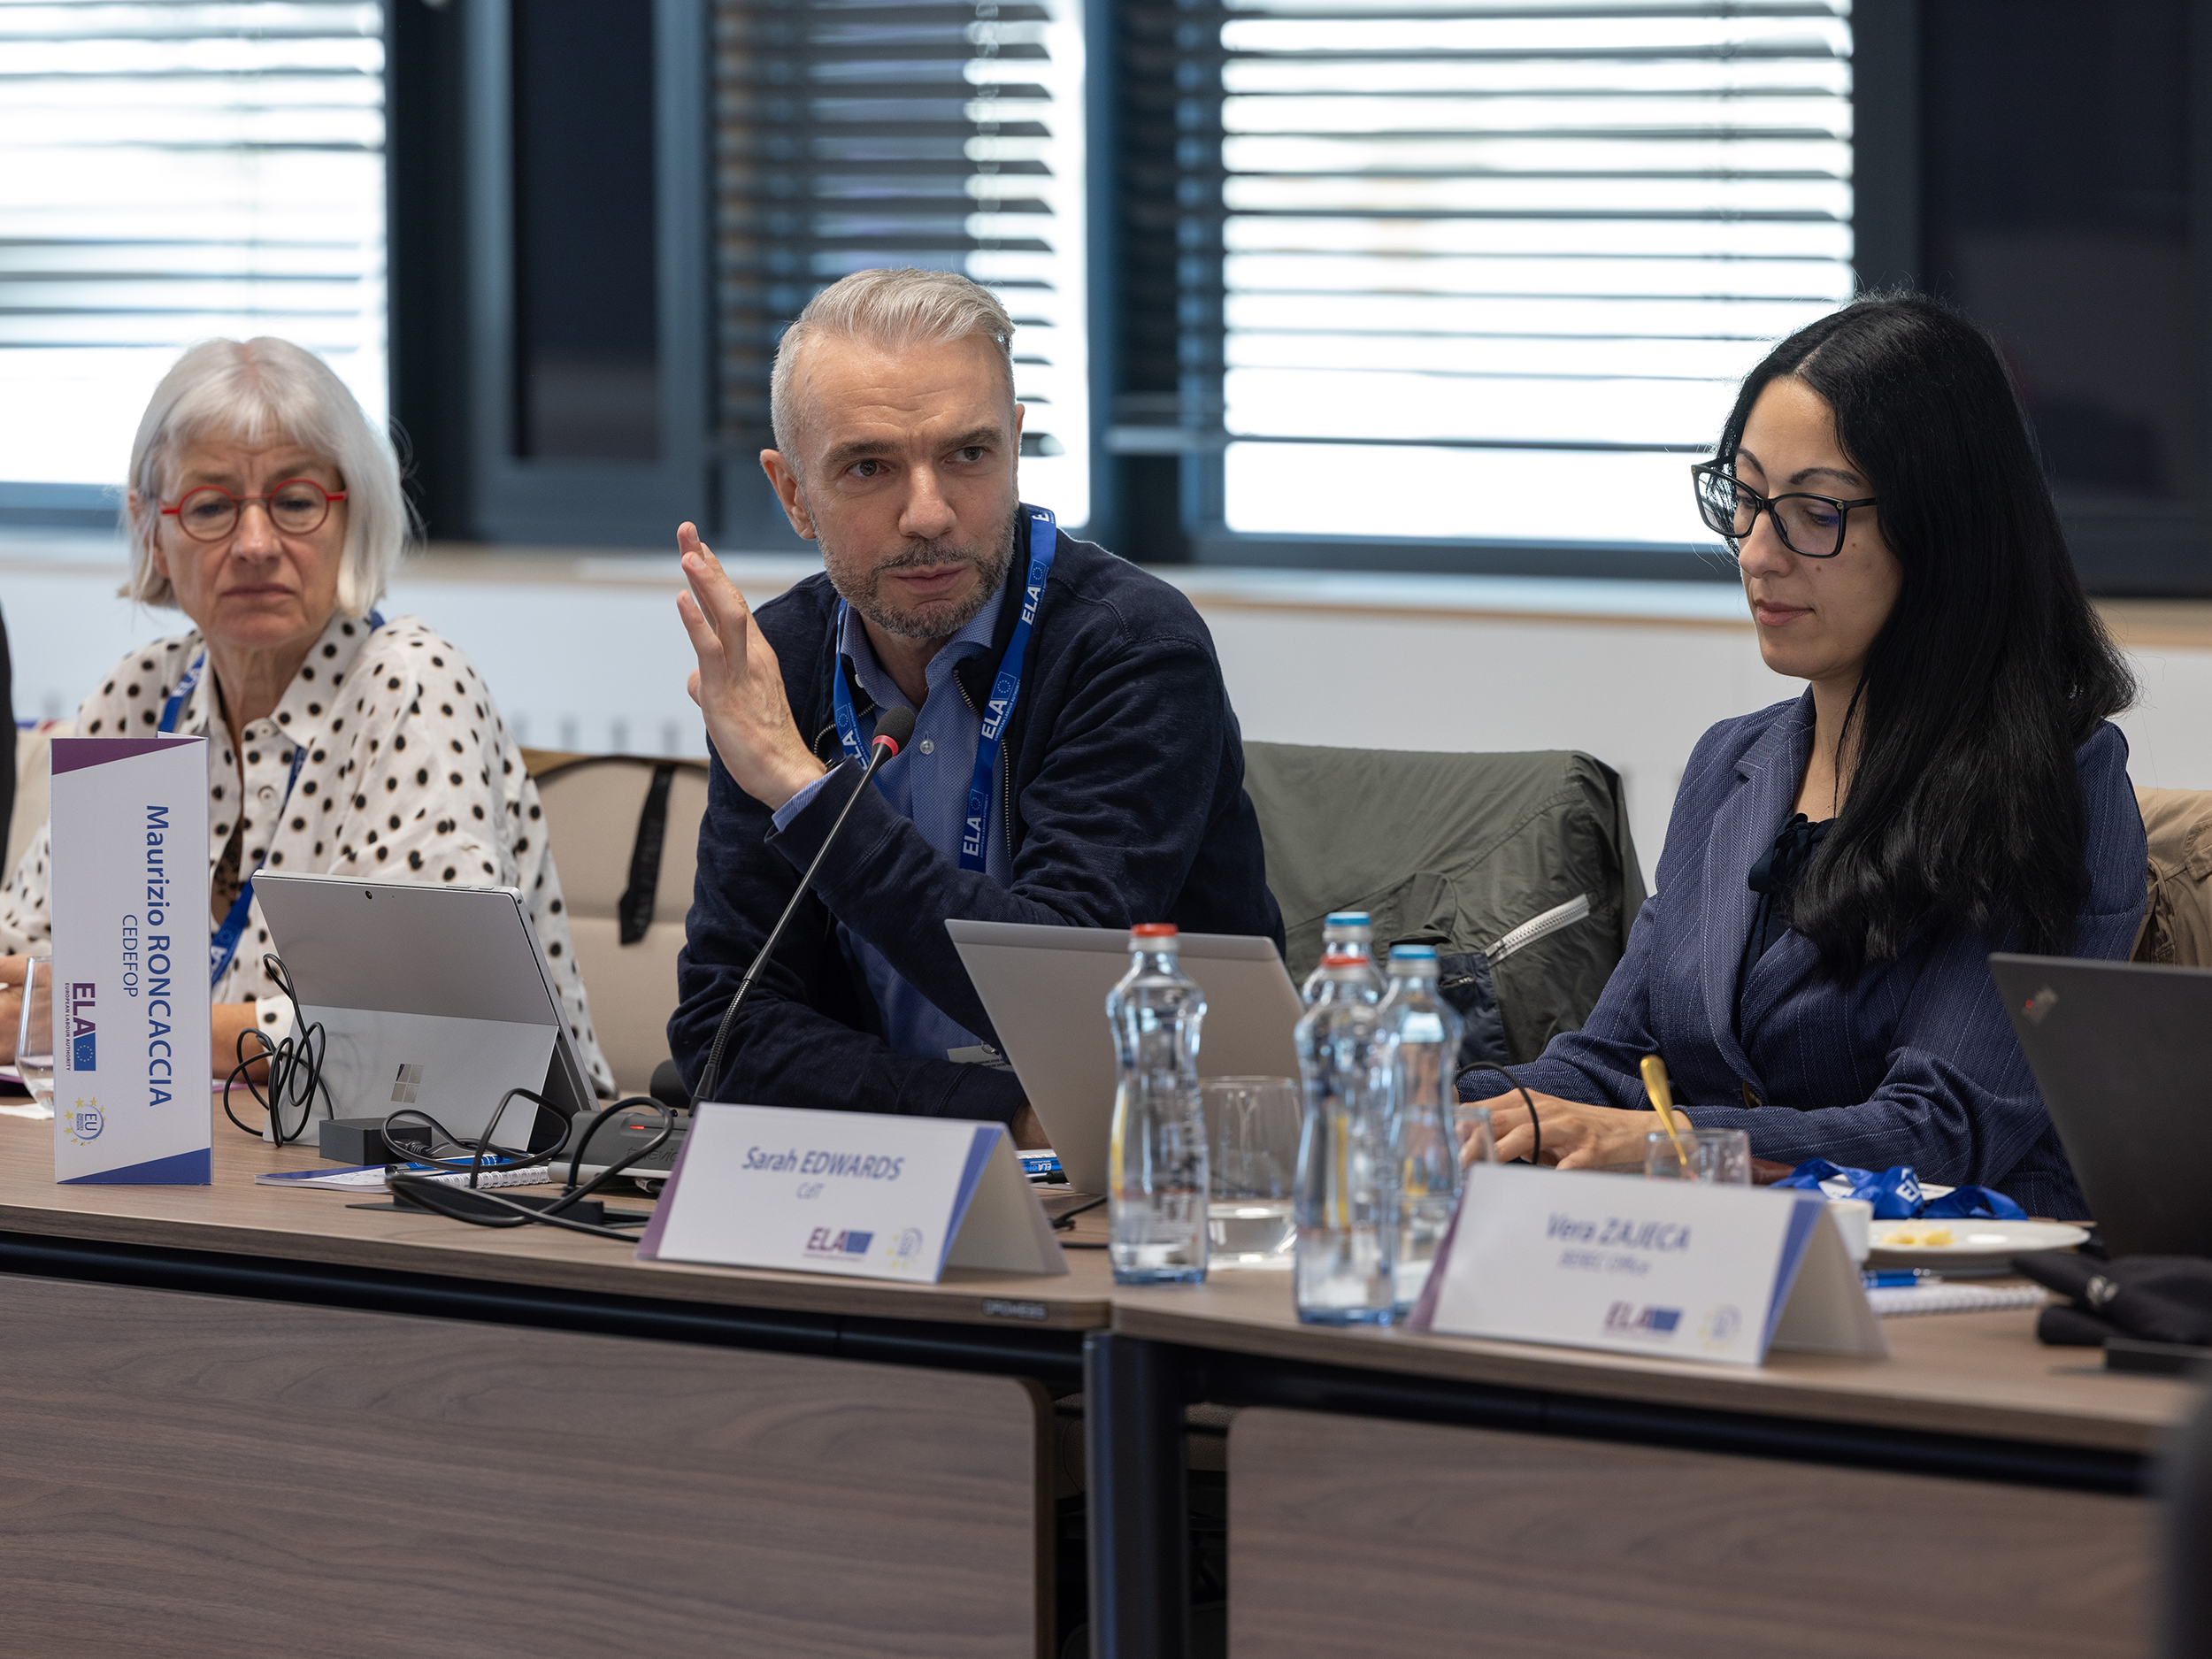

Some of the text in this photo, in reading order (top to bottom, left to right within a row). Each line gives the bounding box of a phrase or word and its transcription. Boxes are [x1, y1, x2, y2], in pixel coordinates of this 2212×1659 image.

[1021, 586, 1041, 626] ELA
[981, 700, 1008, 740] ELA
[995, 718, 1007, 741] EUROPEAN
[1004, 703, 1014, 719] LABOUR
[963, 818, 981, 856] ELA
[122, 914, 138, 997] CEDEFOP
[146, 805, 173, 1107] Maurizio RONCACCIA
[73, 983, 96, 1037] ELA
[85, 1113, 97, 1131] EU
[742, 1146, 905, 1181] Sarah EDWARDS
[806, 1226, 847, 1252] ELA
[1548, 1212, 1691, 1253] Vera ZAJECA
[1603, 1300, 1651, 1329] ELA
